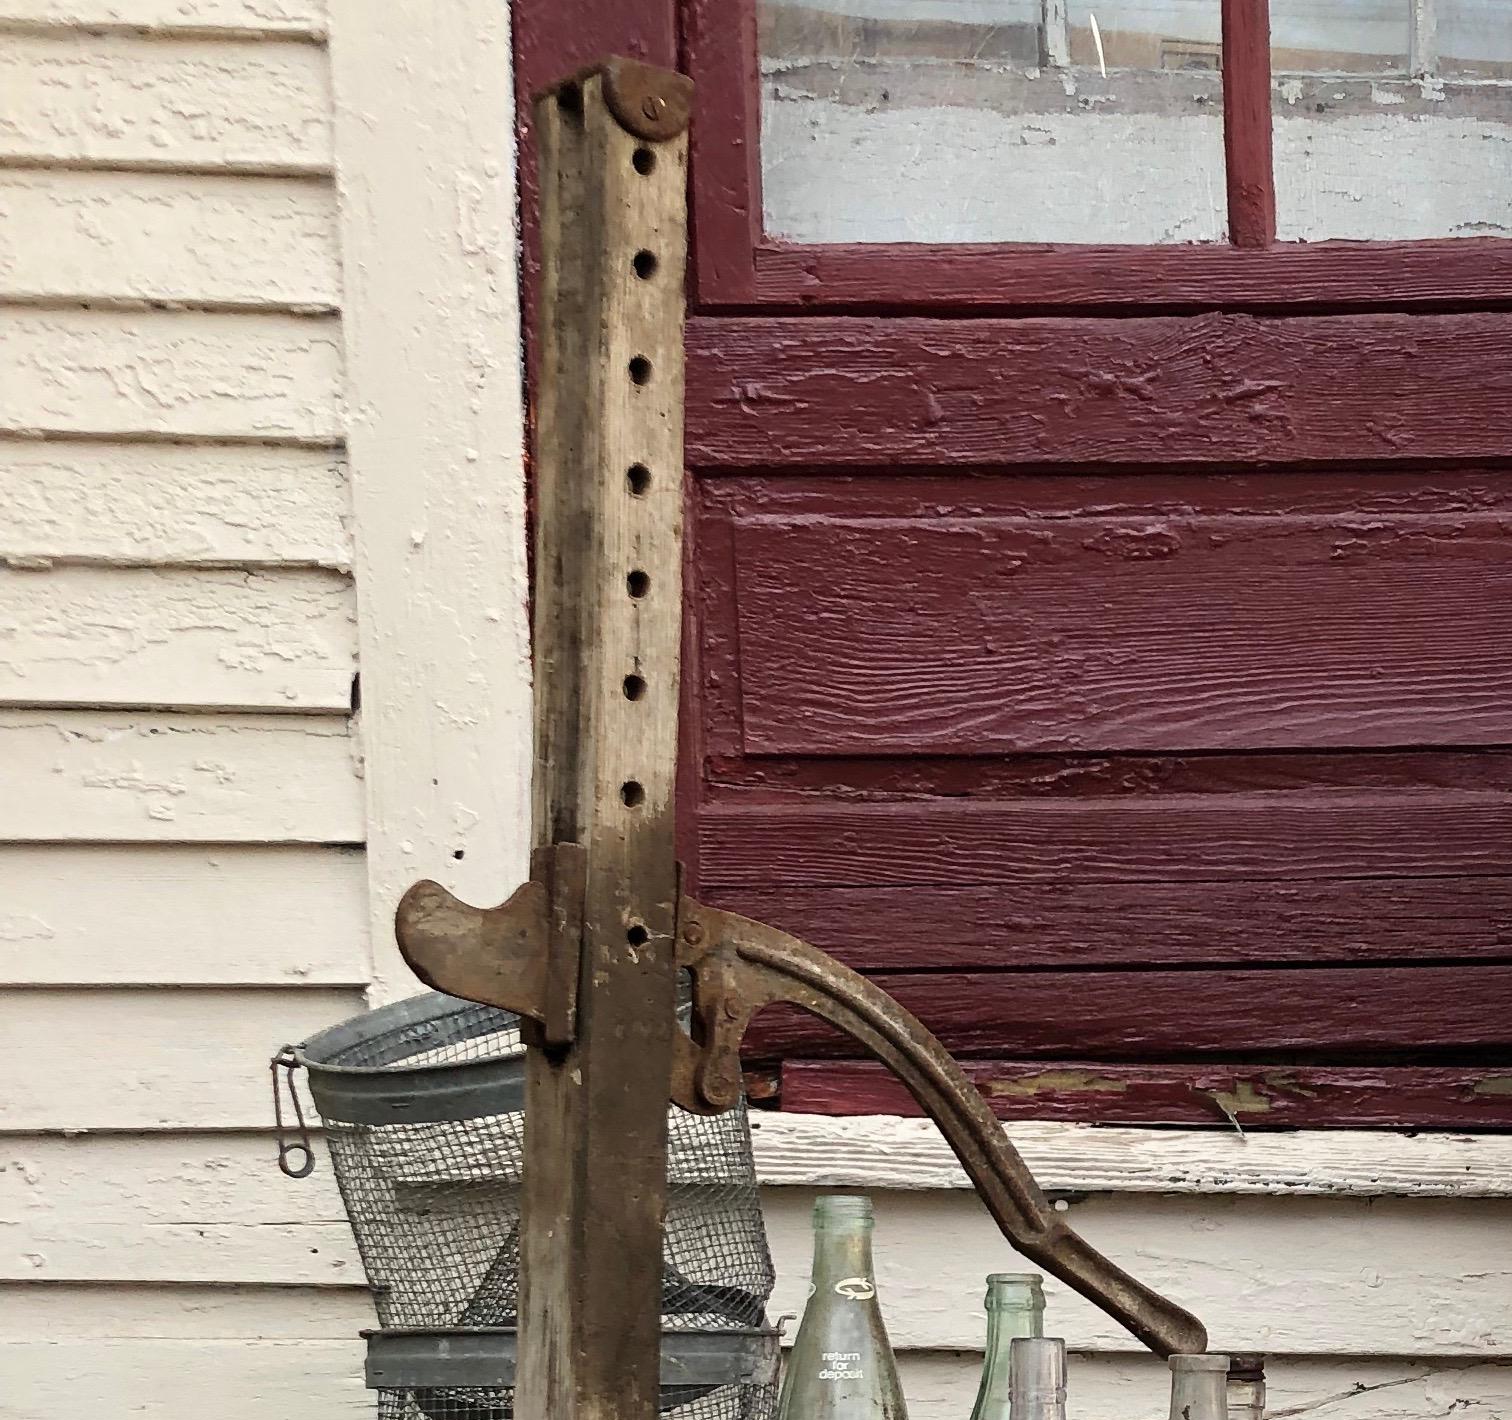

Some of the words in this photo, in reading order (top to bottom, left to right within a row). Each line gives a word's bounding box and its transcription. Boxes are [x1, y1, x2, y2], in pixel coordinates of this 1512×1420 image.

[822, 1351, 861, 1361] return
[832, 1360, 849, 1370] for
[818, 1368, 865, 1381] deposit
